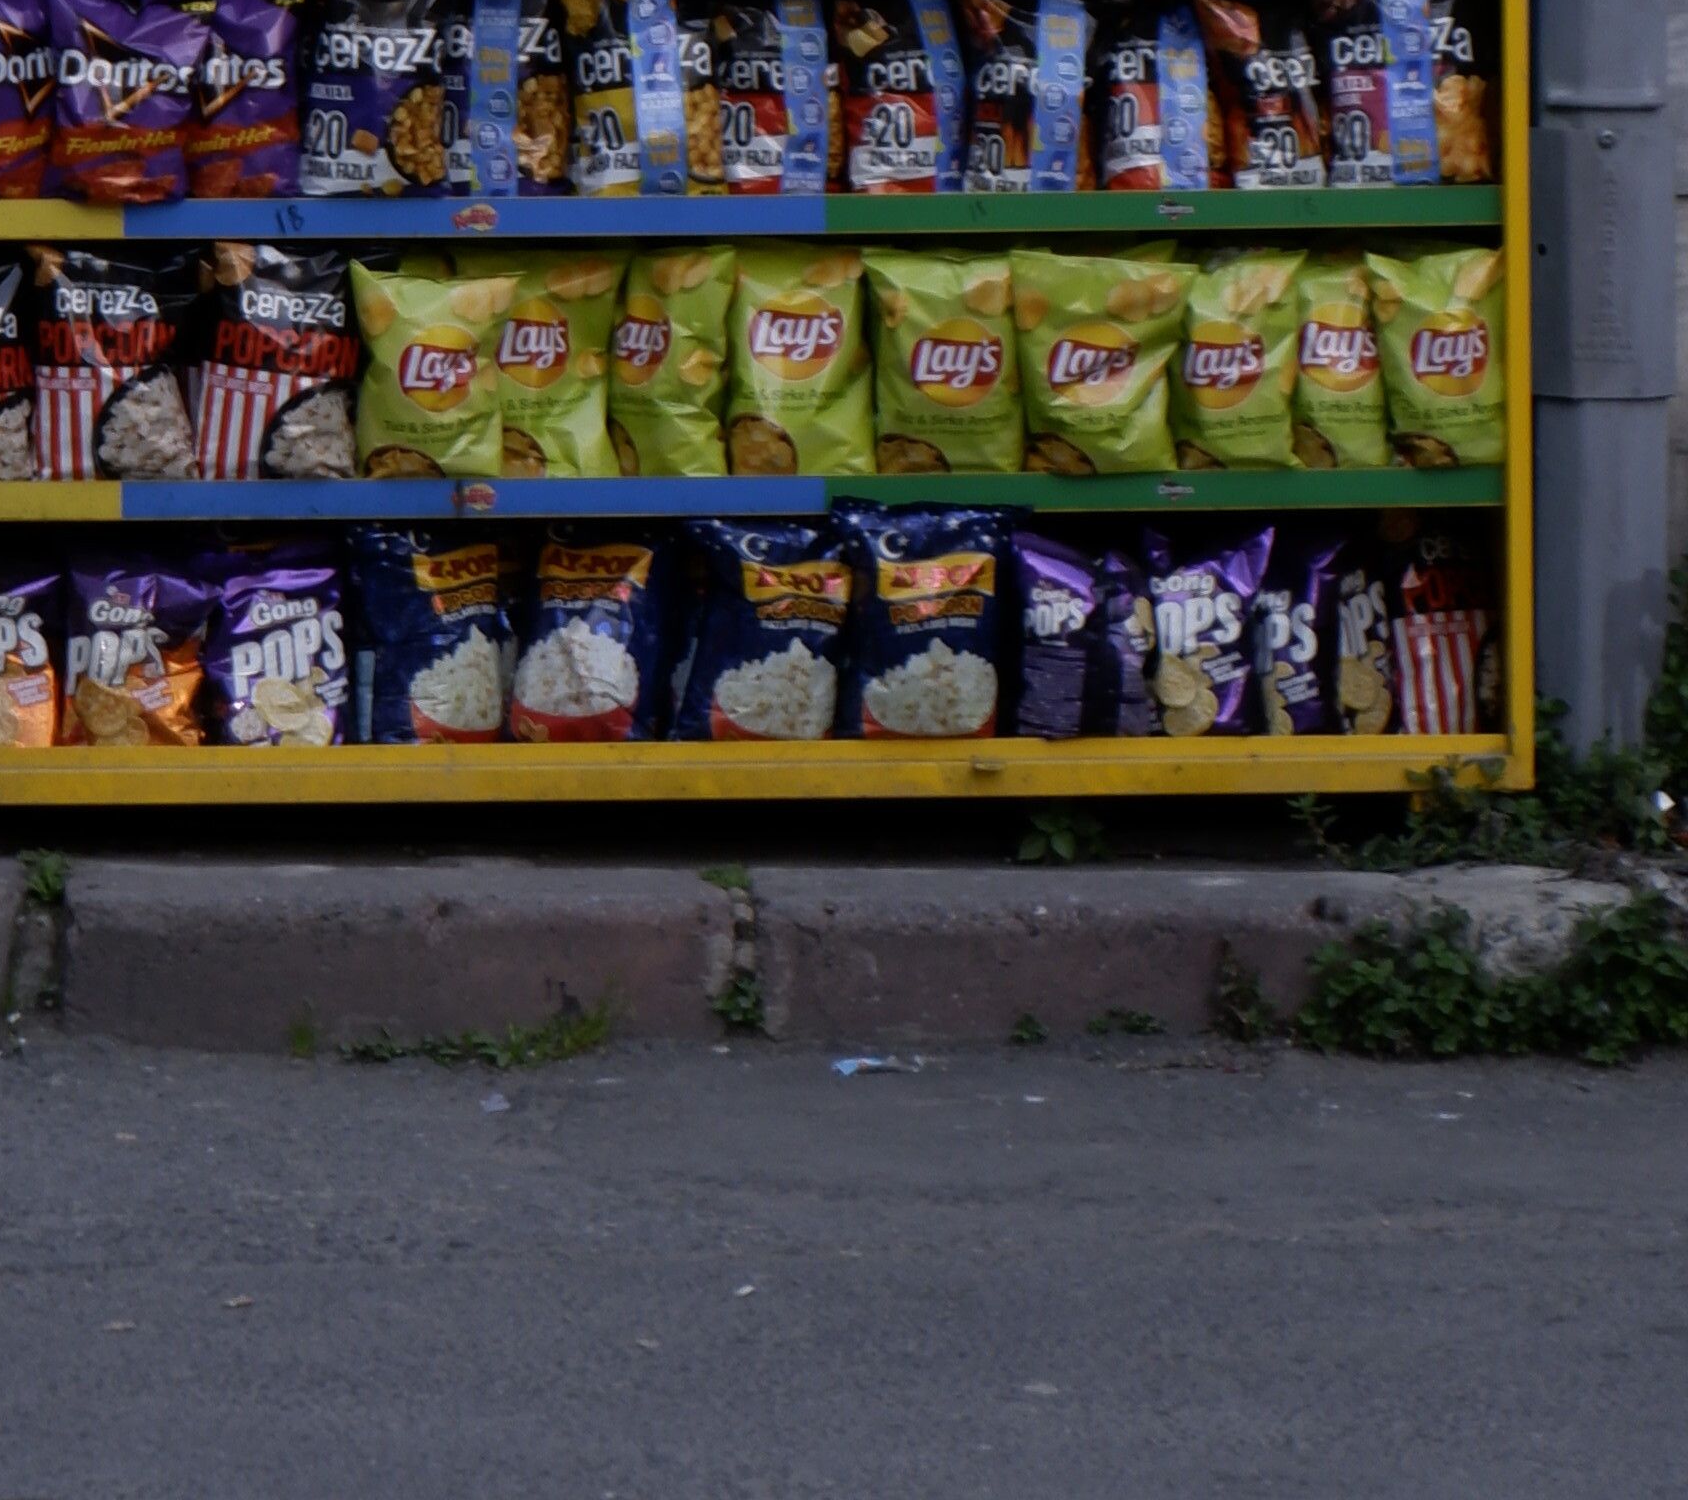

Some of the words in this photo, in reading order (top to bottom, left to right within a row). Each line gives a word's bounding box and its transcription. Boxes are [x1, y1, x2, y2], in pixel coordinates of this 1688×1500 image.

[58, 49, 196, 94] Doritos
[276, 205, 305, 234] 18
[37, 319, 176, 367] POPCORN
[214, 318, 361, 380] POPCORN
[500, 319, 567, 370] Lay's
[755, 310, 844, 362] Lay's
[1052, 339, 1134, 384] Lay's
[1301, 321, 1379, 375] Lay's
[1415, 324, 1486, 377] Lay's
[915, 336, 1002, 389] Lay's
[1185, 337, 1263, 390] Lay's
[250, 596, 319, 627] Gong
[65, 625, 170, 698] POPS
[231, 608, 349, 700] POPS
